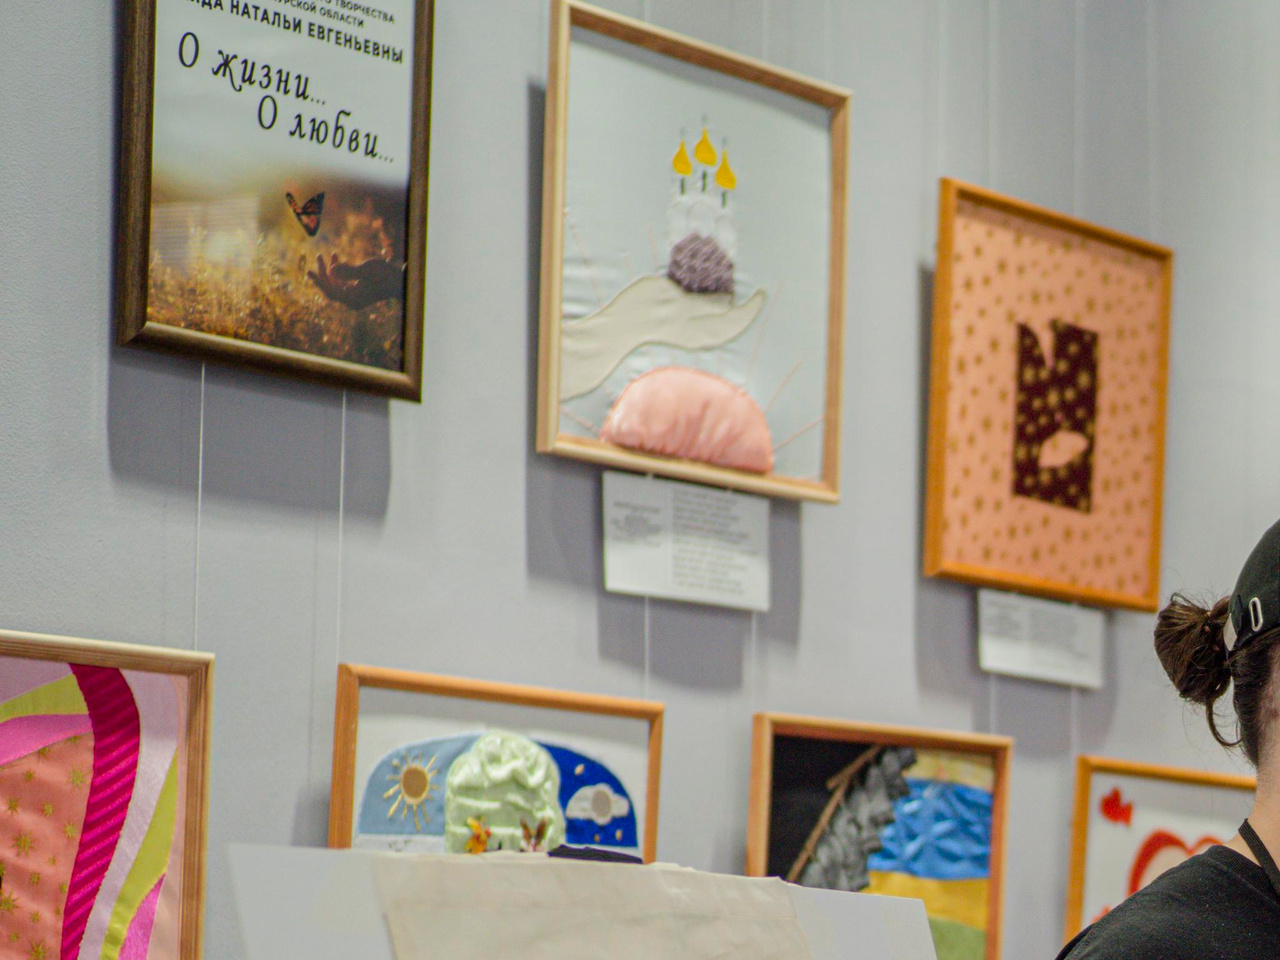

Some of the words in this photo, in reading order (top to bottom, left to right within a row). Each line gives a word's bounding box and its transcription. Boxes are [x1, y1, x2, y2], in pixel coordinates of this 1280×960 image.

[319, 6, 365, 28] ОБЛАСТИ
[335, 0, 396, 24] ТВОРЧЕСТВА
[178, 32, 199, 67] О
[230, 0, 302, 34] НАТАЛЬИ
[307, 21, 404, 64] ЕВГЕНЬЕВНЫ
[257, 95, 278, 130] О
